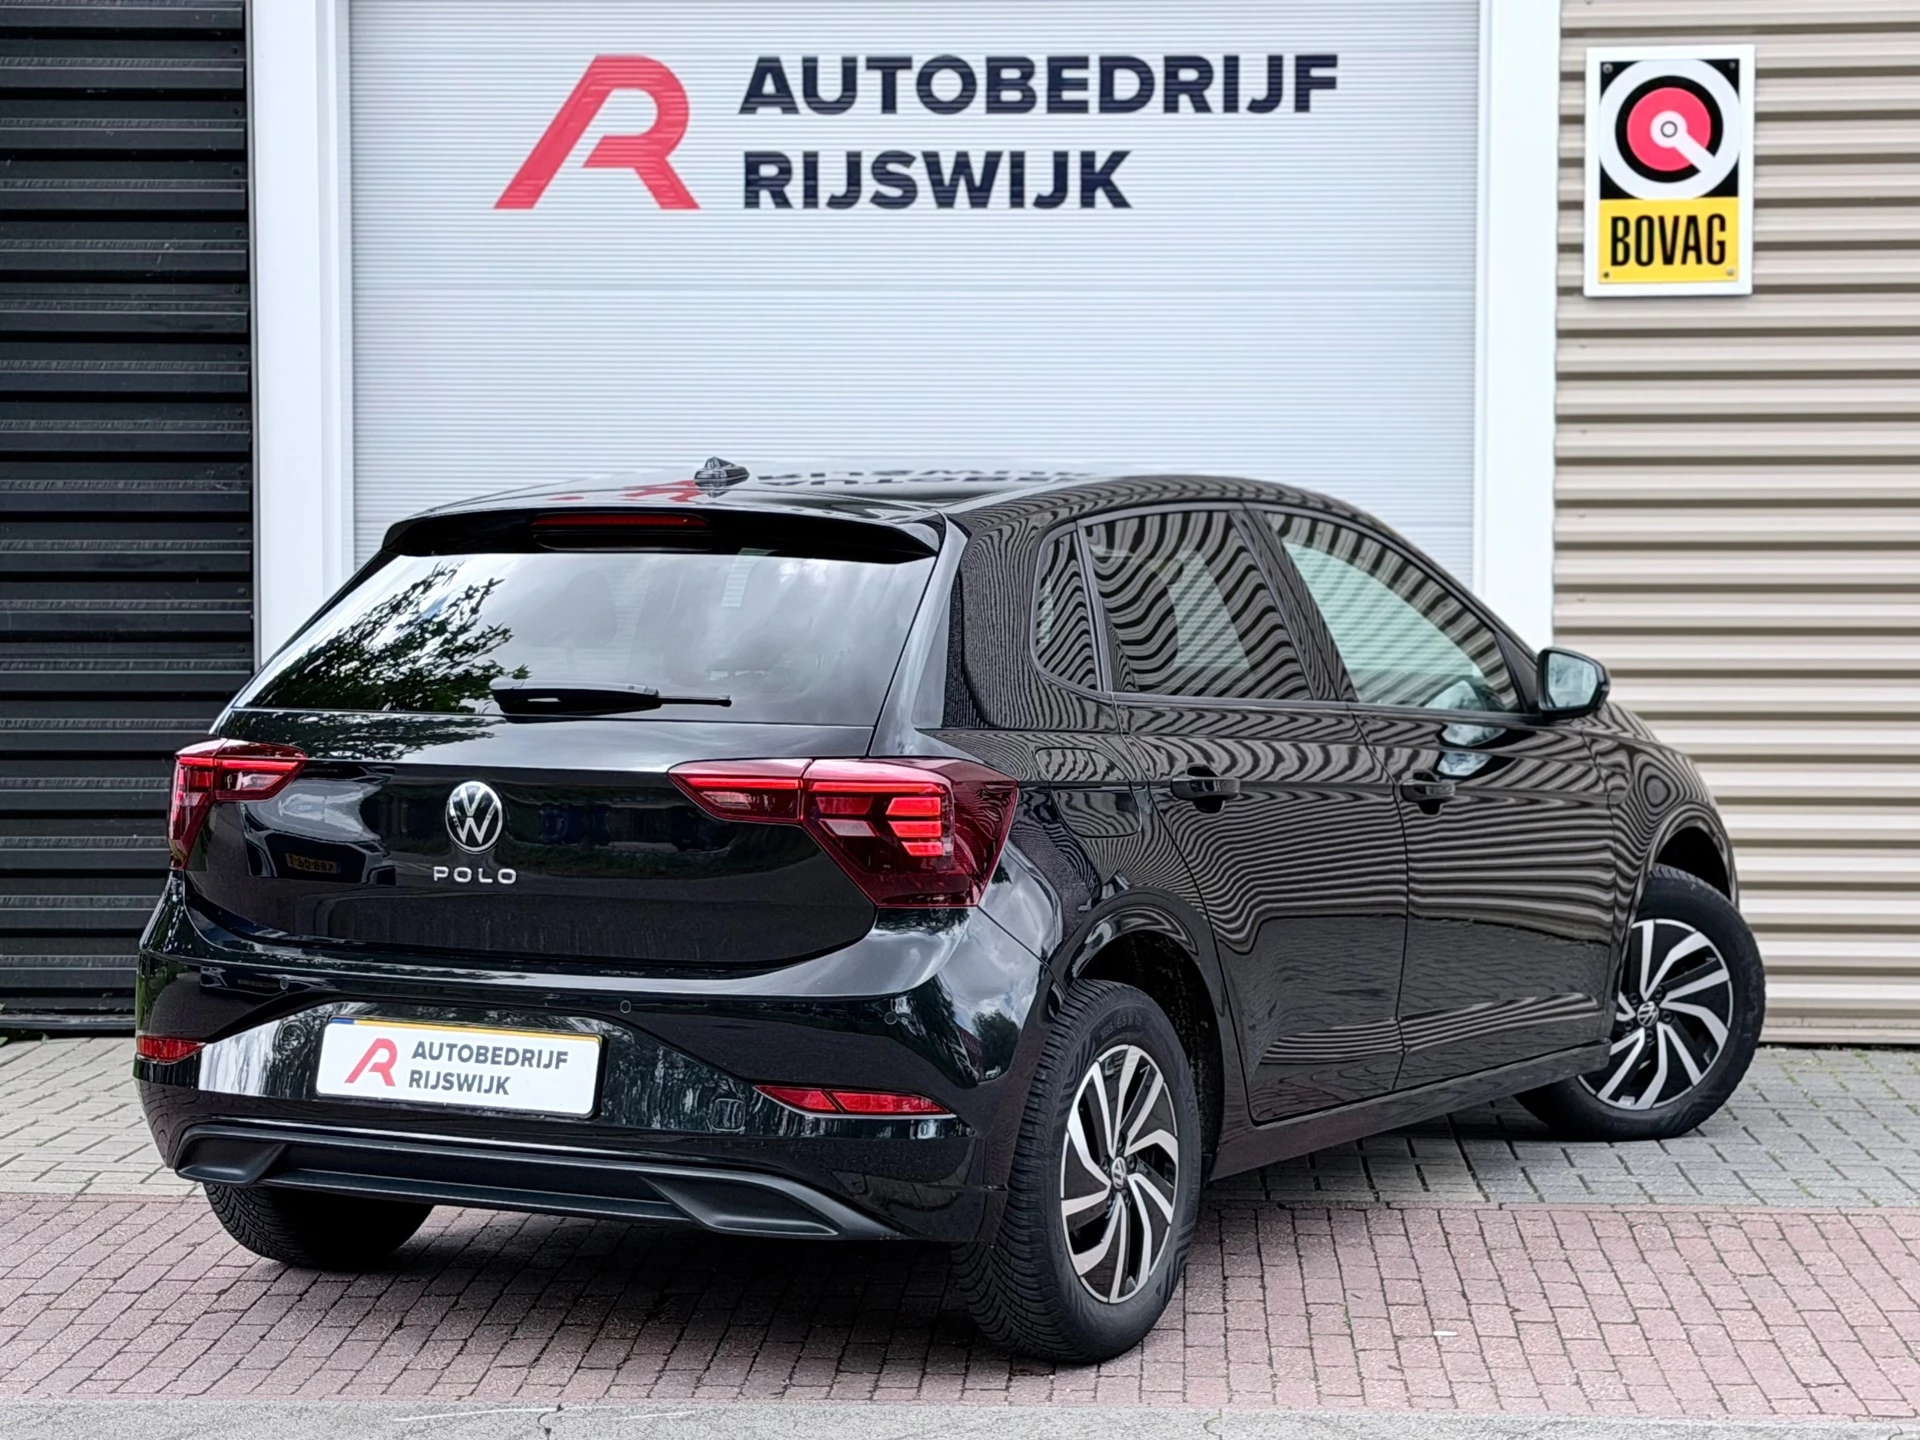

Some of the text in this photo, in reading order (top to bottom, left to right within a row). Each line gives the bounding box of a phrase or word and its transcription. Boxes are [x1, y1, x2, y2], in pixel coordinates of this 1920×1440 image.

[738, 54, 1338, 115] AUTOBEDRIJF
[744, 150, 1132, 210] RIJSWIJK
[1610, 213, 1727, 267] BOVAG
[432, 865, 517, 885] POLO
[411, 1040, 569, 1070] AUTOBEDRIJF
[408, 1069, 512, 1096] RIJSWIJK
